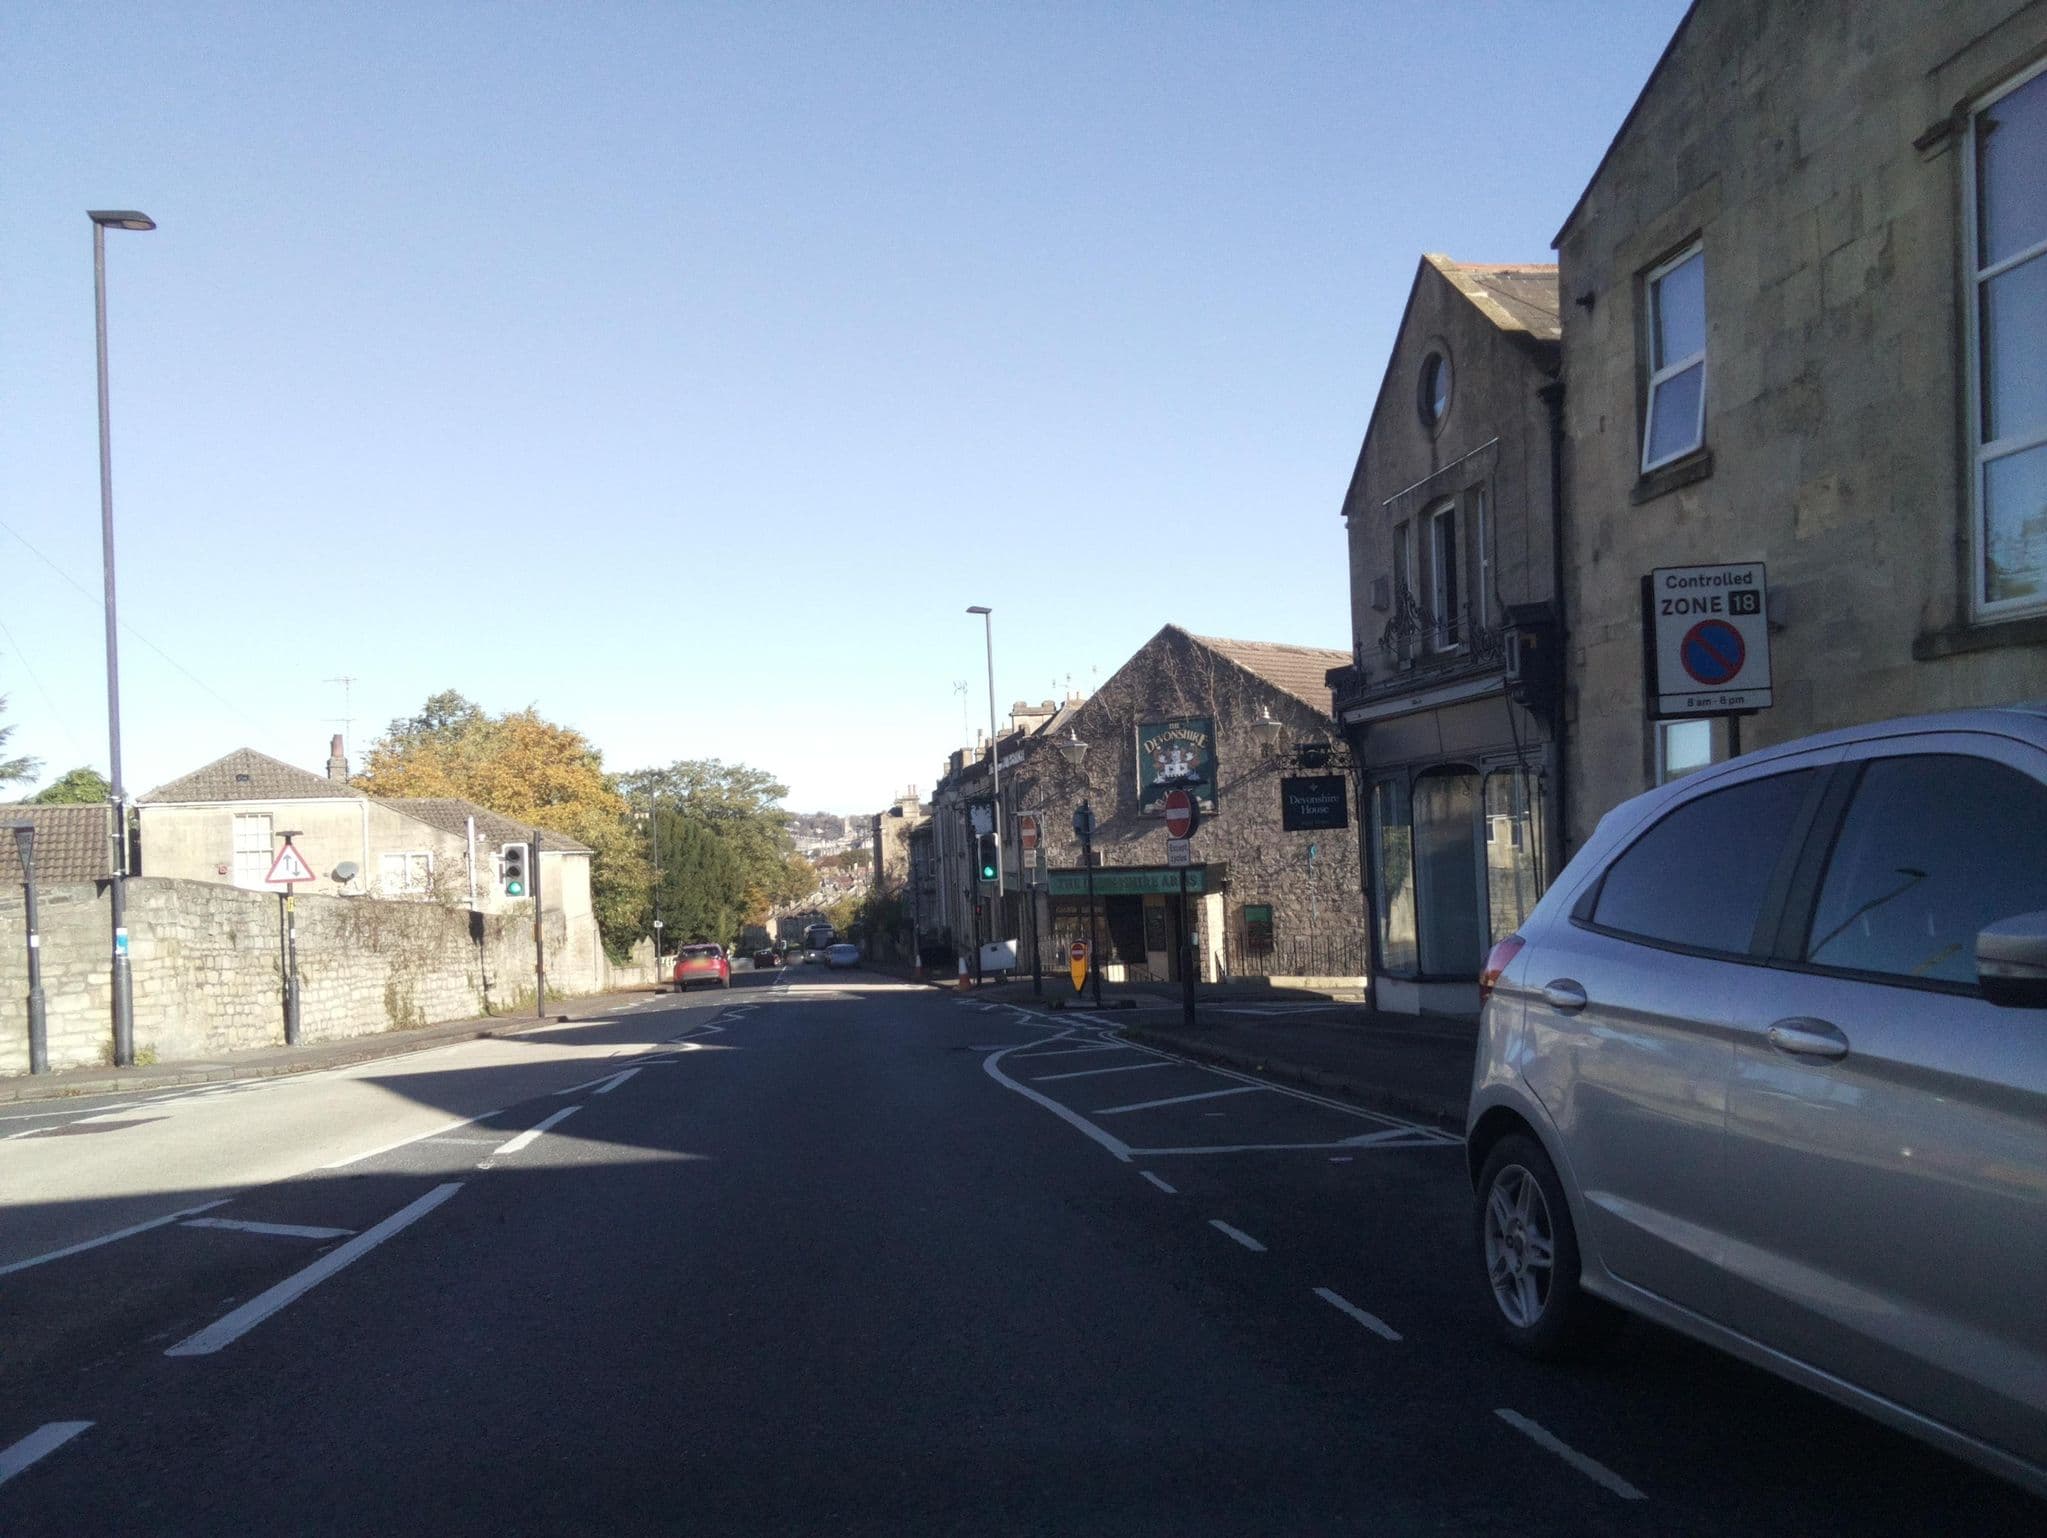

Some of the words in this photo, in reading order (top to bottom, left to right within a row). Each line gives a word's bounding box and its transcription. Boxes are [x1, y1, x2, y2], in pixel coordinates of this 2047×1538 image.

[1666, 571, 1752, 589] Controlled
[1661, 596, 1723, 616] ZONE
[1733, 594, 1755, 613] 18
[1696, 698, 1712, 706] am
[1728, 696, 1744, 706] pm
[1143, 729, 1209, 754] DEVONSHIRE
[1289, 793, 1340, 805] Devonshire
[1301, 805, 1329, 815] House
[1161, 872, 1199, 888] ARS
